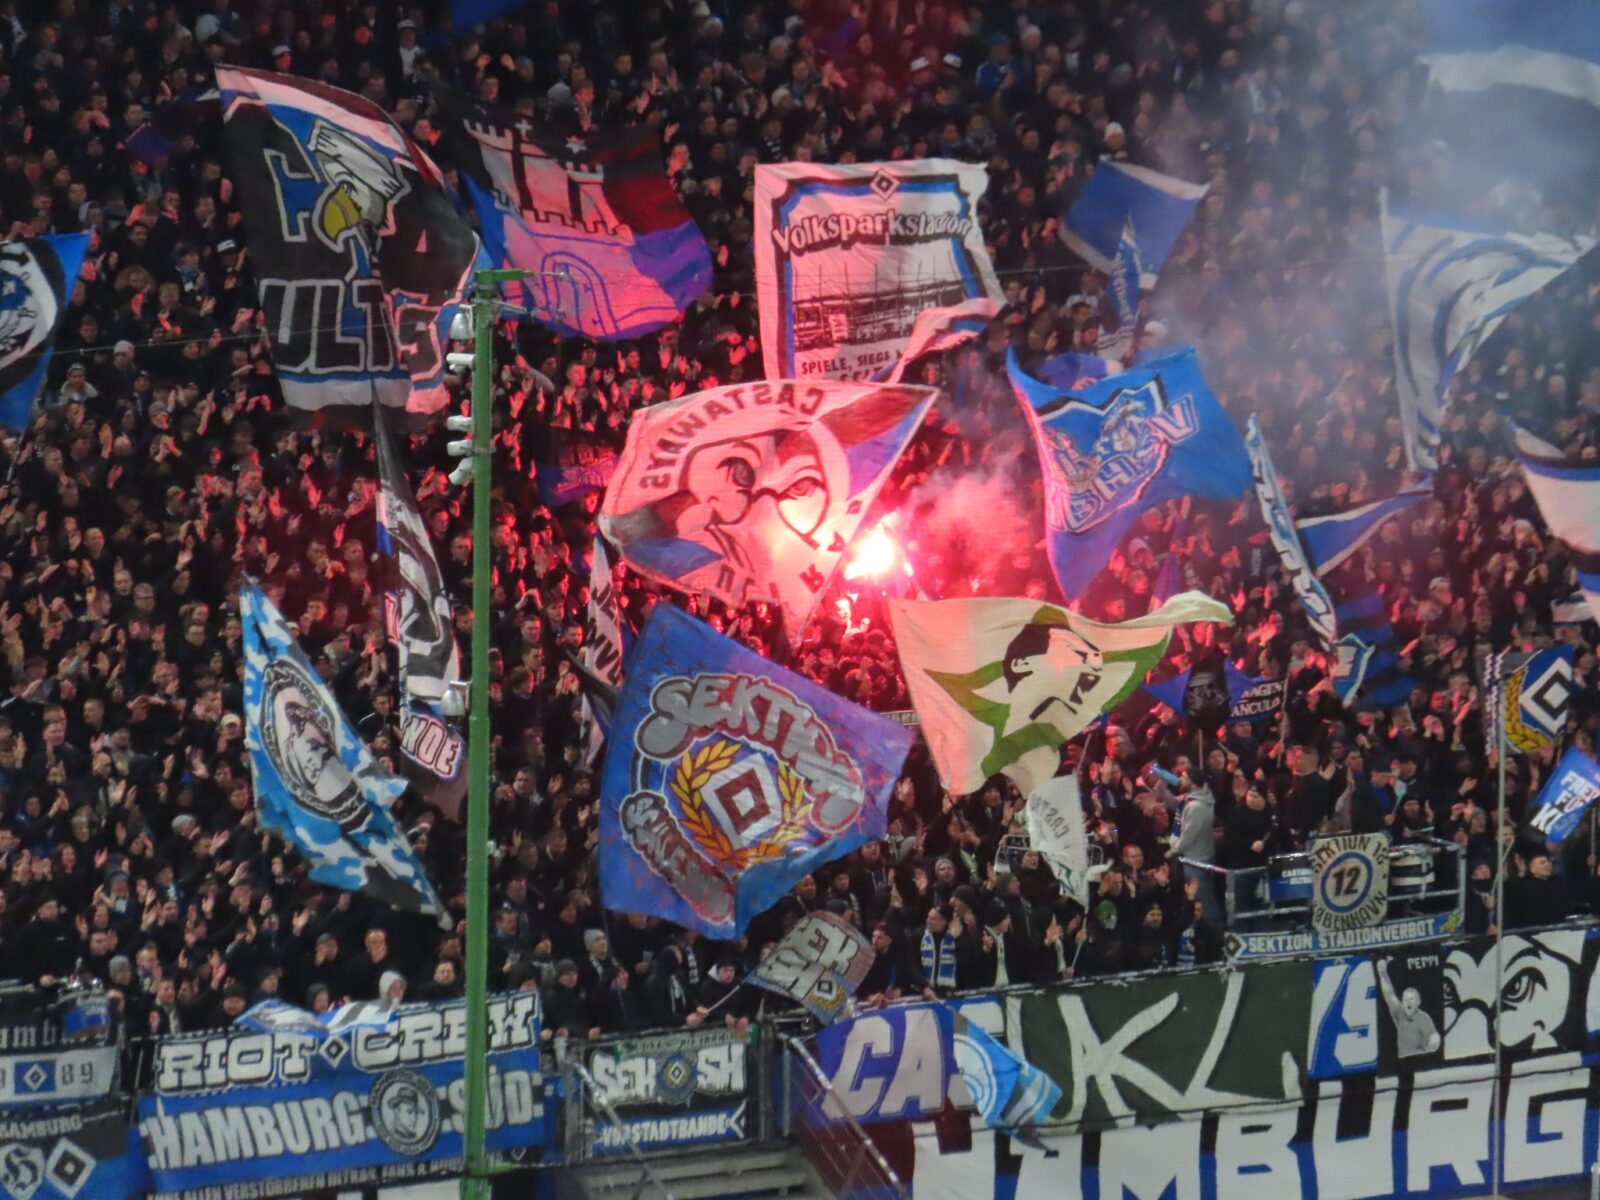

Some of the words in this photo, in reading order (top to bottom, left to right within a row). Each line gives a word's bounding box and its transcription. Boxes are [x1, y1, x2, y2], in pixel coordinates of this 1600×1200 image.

[771, 209, 973, 255] Volksparkstadion
[1332, 867, 1362, 897] 12
[1250, 932, 1312, 953] SEKTION
[1319, 918, 1435, 949] STADIONVERBOT
[157, 1034, 314, 1091] RIOT
[150, 1091, 368, 1168] HAMBURG
